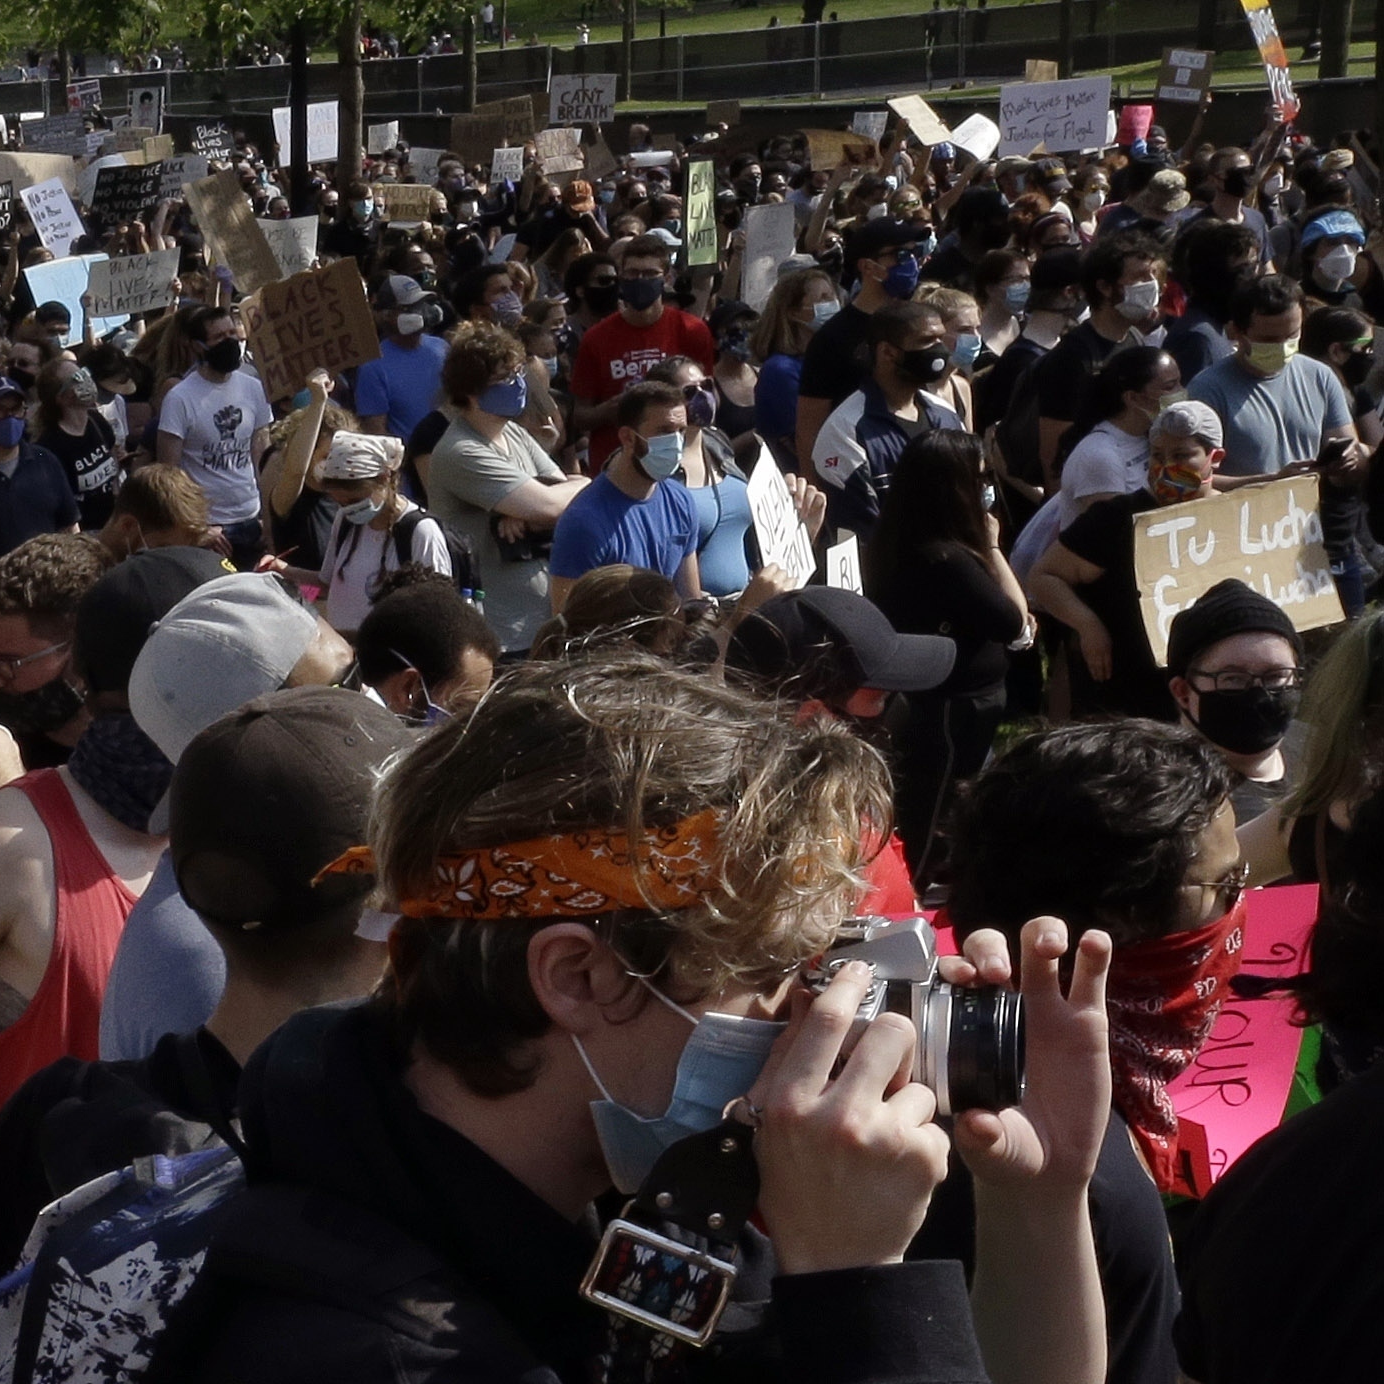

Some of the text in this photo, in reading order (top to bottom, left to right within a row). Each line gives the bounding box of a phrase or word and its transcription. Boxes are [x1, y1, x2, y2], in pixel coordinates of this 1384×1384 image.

[109, 255, 159, 276] BLACK
[109, 273, 154, 298] LIVES
[246, 271, 338, 332] BLACK
[256, 300, 345, 362] LIVES
[264, 334, 360, 402] MATTER
